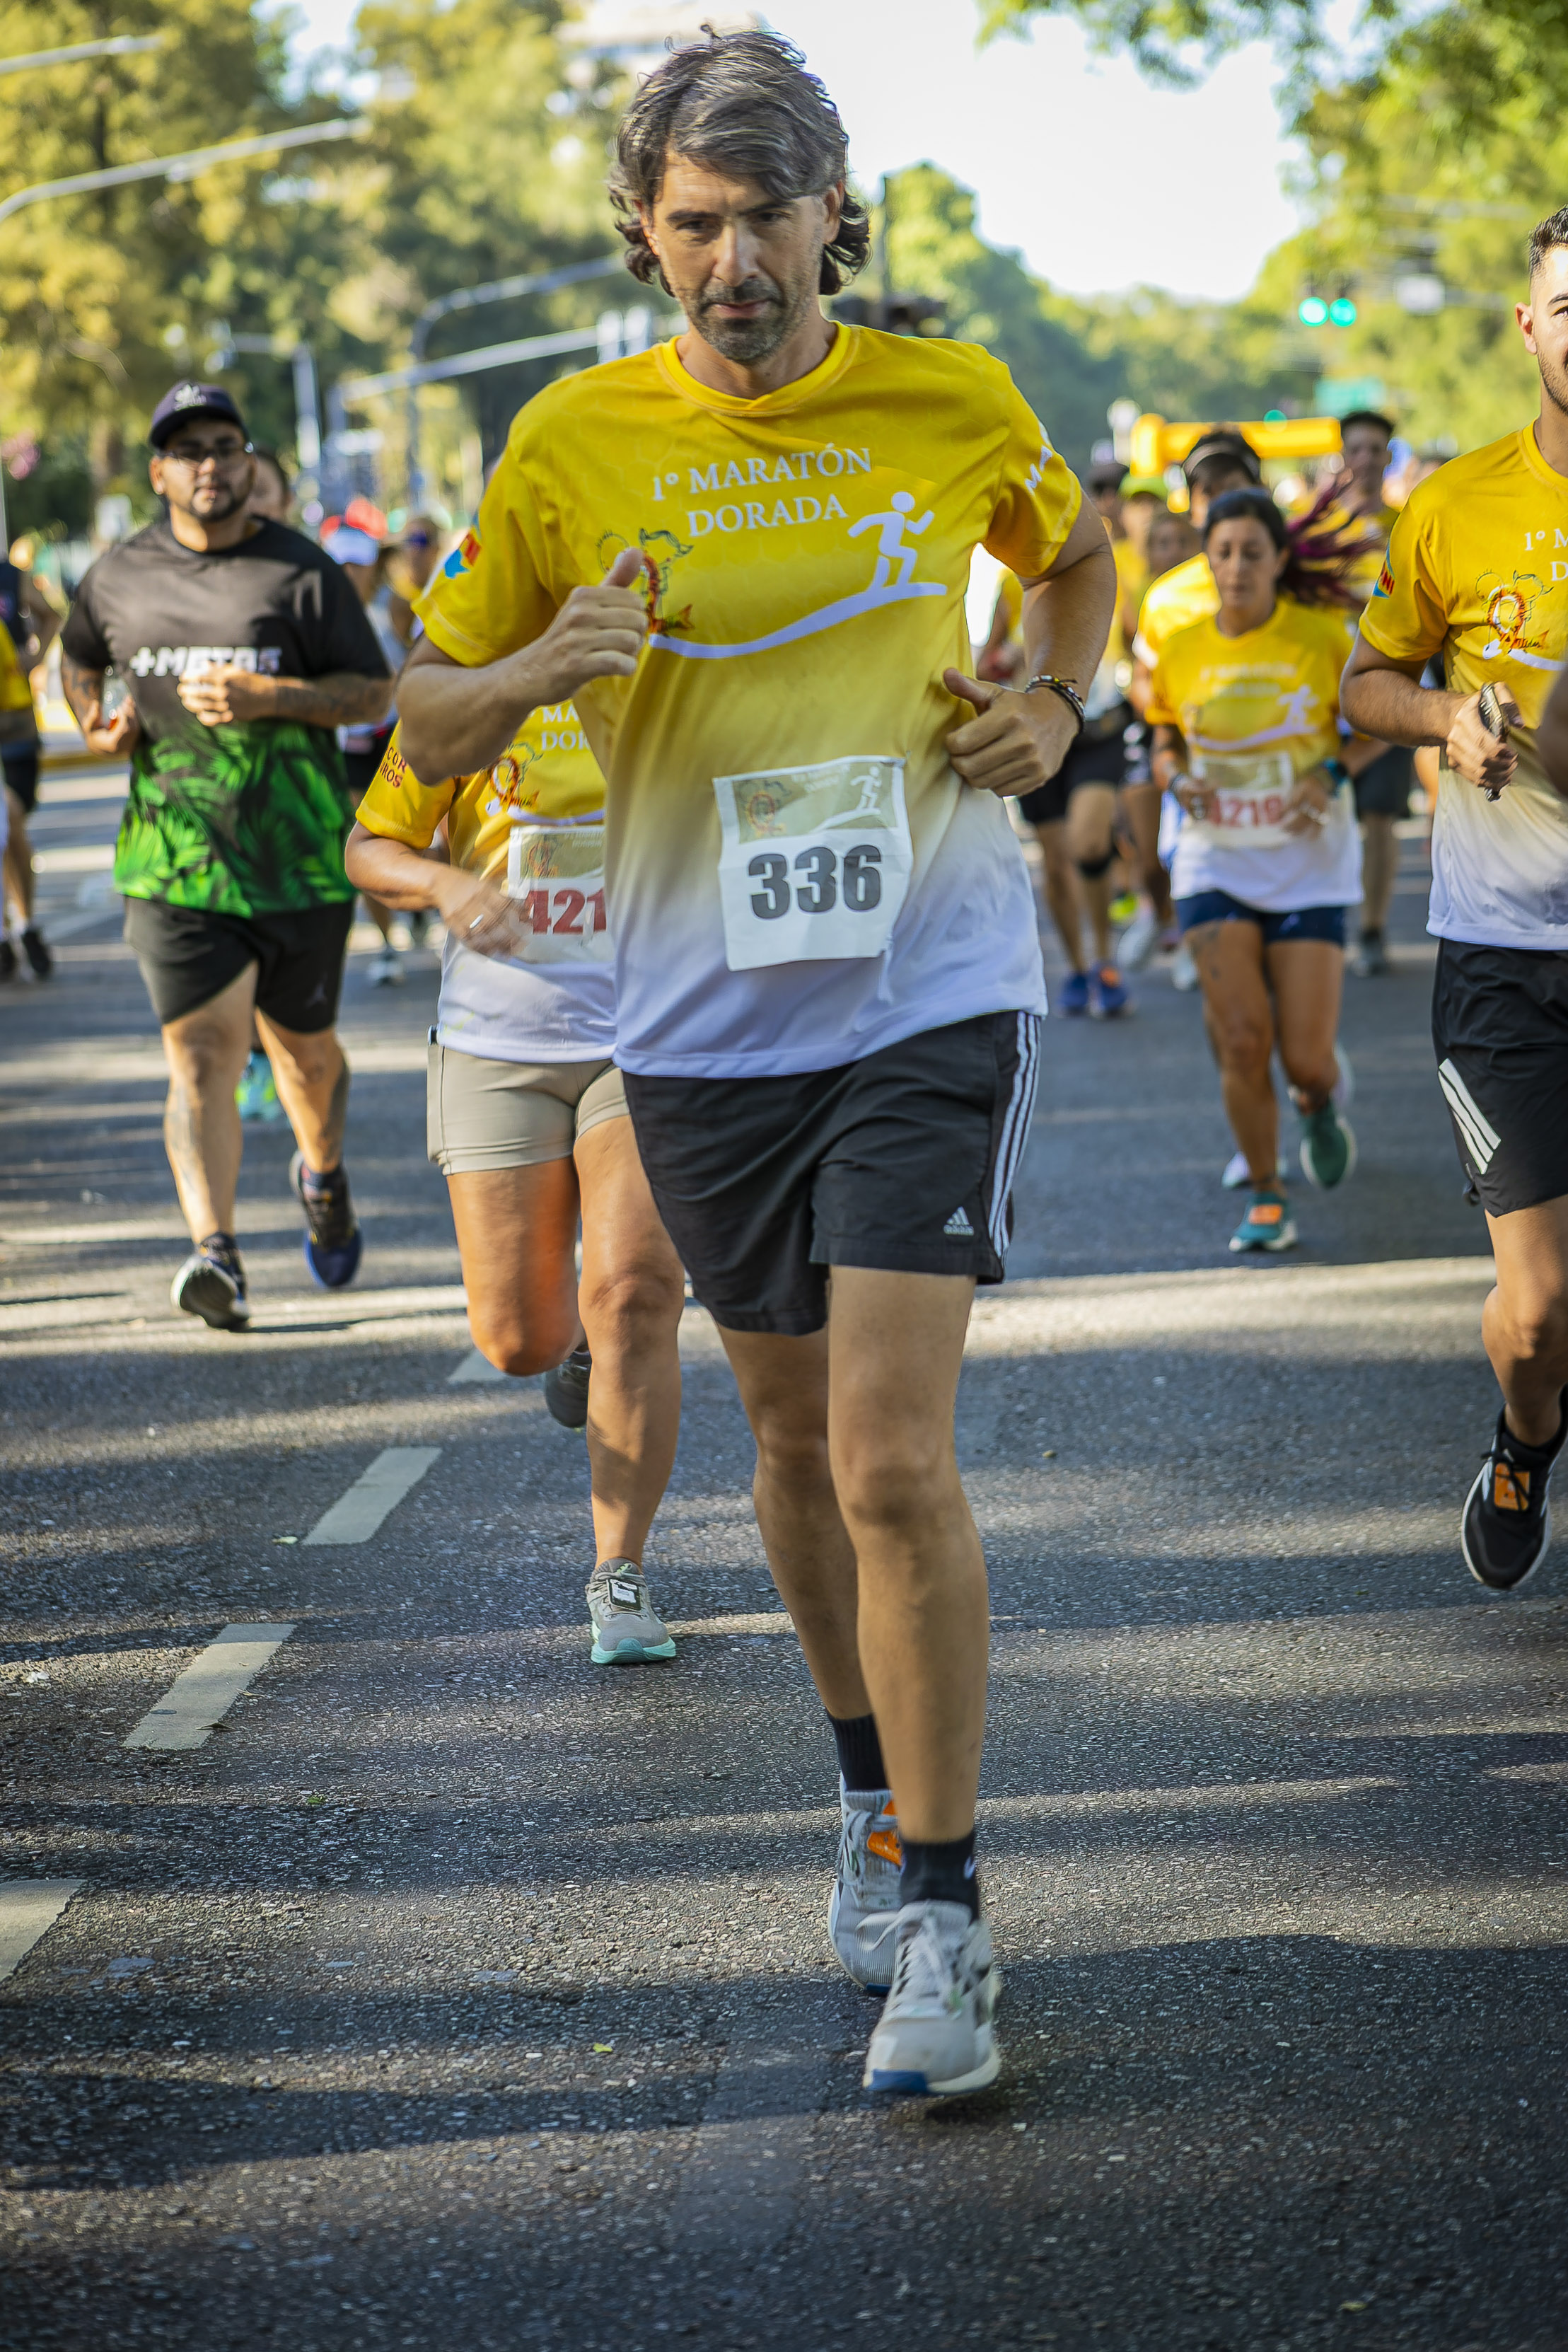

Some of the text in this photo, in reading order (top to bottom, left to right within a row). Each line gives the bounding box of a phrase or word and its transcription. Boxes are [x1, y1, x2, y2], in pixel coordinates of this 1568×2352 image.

[688, 442, 872, 494] MARATÓN
[687, 494, 849, 538] DORADA
[748, 845, 881, 920] 336
